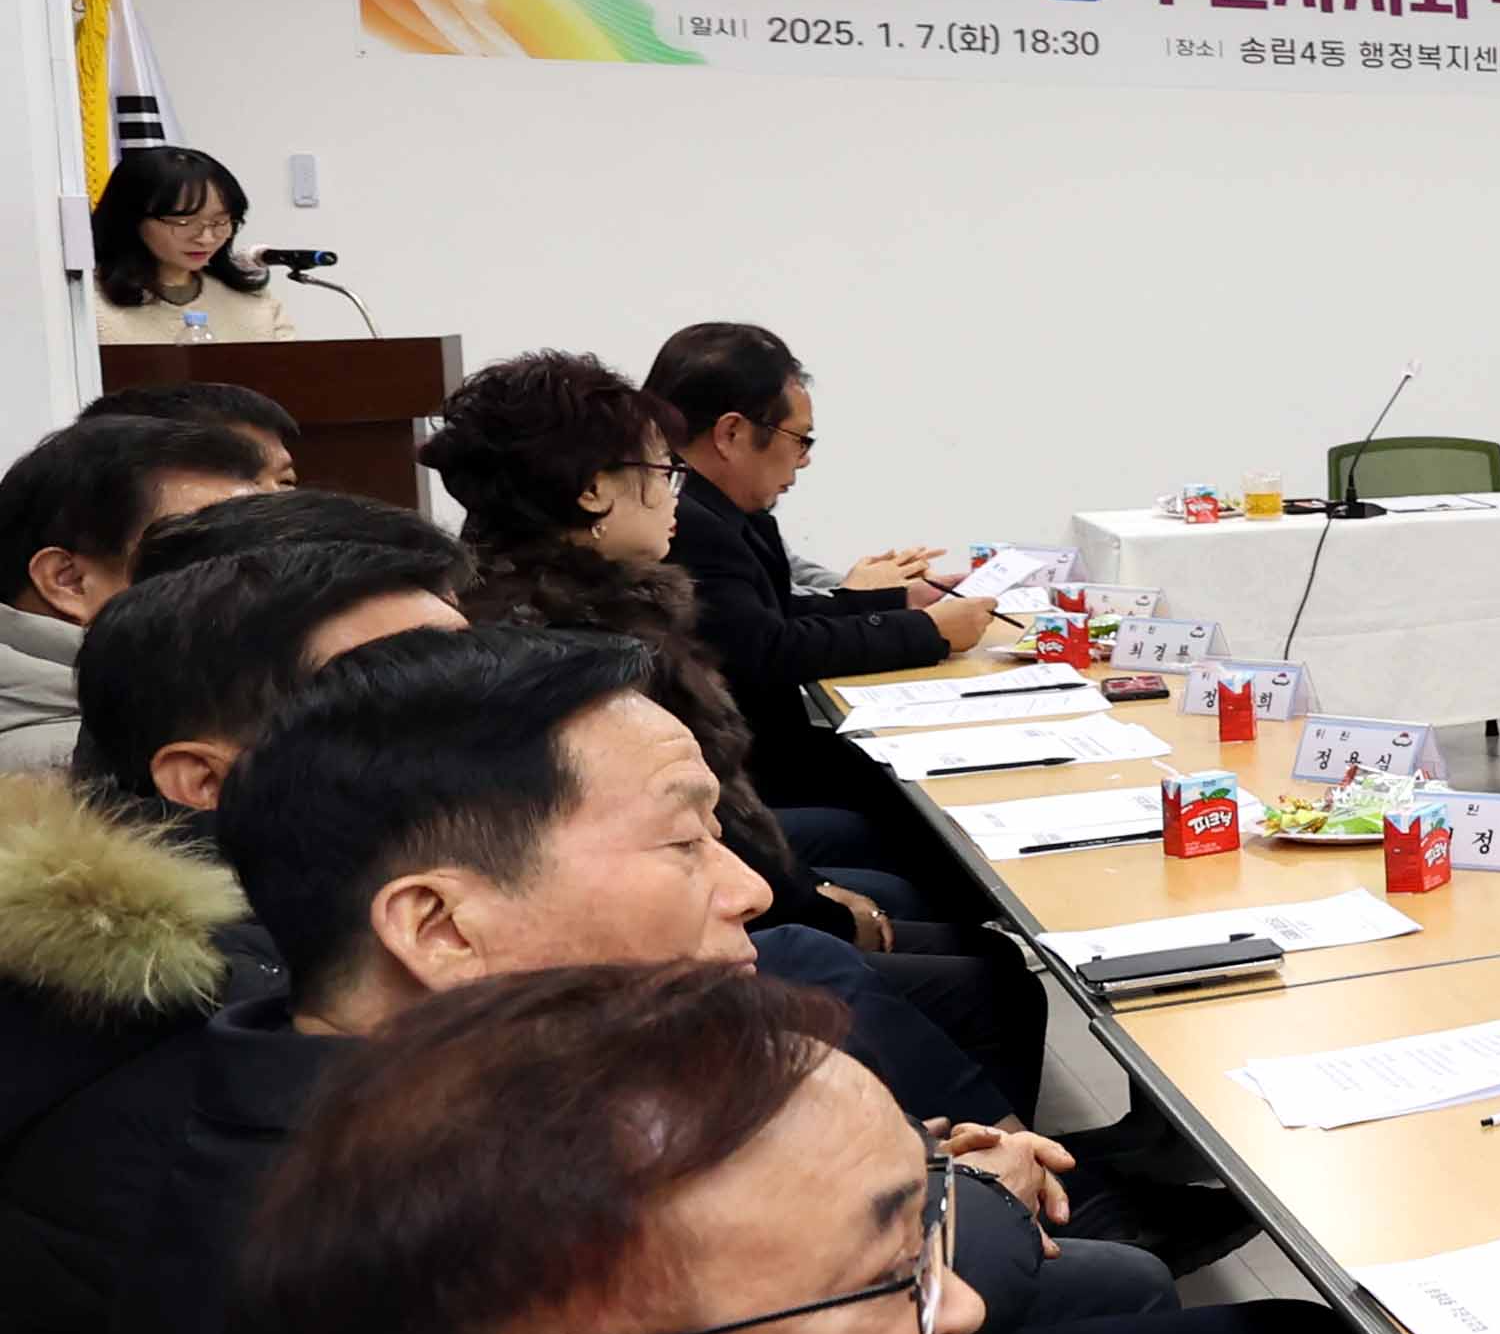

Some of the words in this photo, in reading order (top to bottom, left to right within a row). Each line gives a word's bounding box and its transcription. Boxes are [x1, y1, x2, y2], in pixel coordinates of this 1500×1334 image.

[767, 16, 864, 47] 2025.
[877, 22, 905, 48] 1.
[915, 22, 1000, 55] 7.(화)
[1013, 28, 1100, 56] 18:30
[1239, 36, 1346, 68] 송림4동
[1187, 810, 1233, 836] 피크닉
